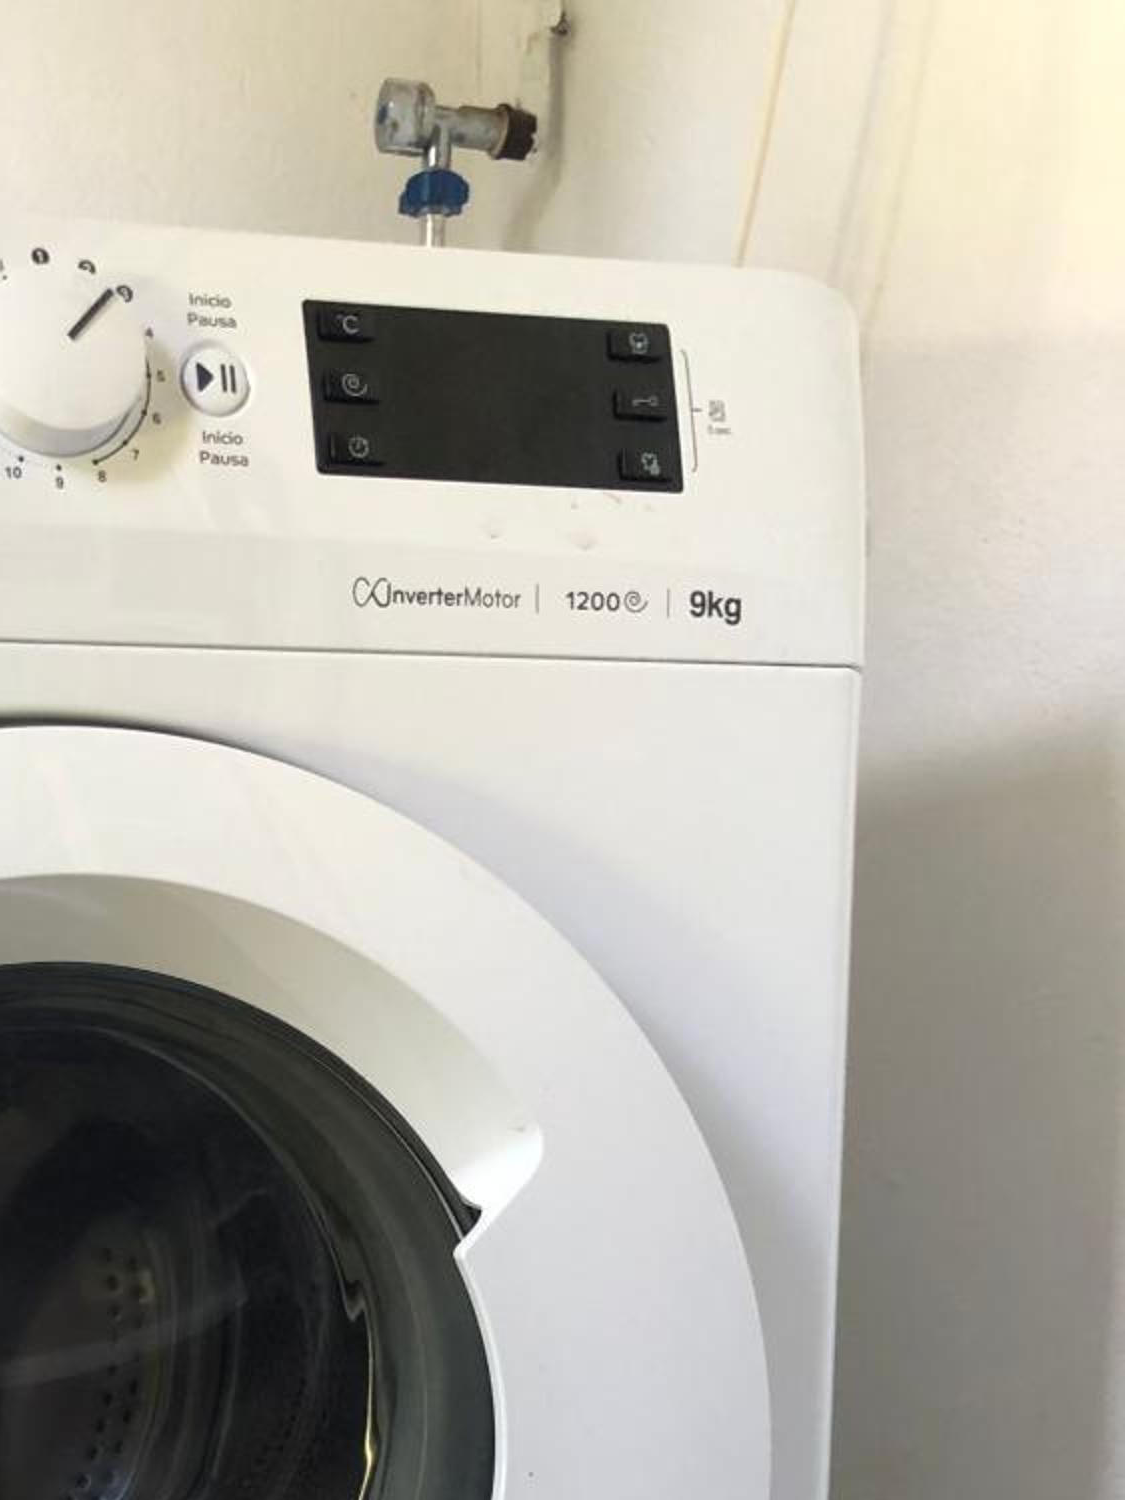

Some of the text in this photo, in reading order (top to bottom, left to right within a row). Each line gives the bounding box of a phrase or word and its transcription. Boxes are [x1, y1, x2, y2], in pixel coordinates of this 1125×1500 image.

[188, 292, 232, 309] Inicio
[187, 311, 237, 329] Pausa
[199, 450, 250, 468] Pausa
[5, 465, 22, 479] 10
[97, 470, 108, 483] 8
[56, 475, 65, 490] 9
[565, 590, 620, 611] 1200
[689, 590, 742, 625] 9kg
